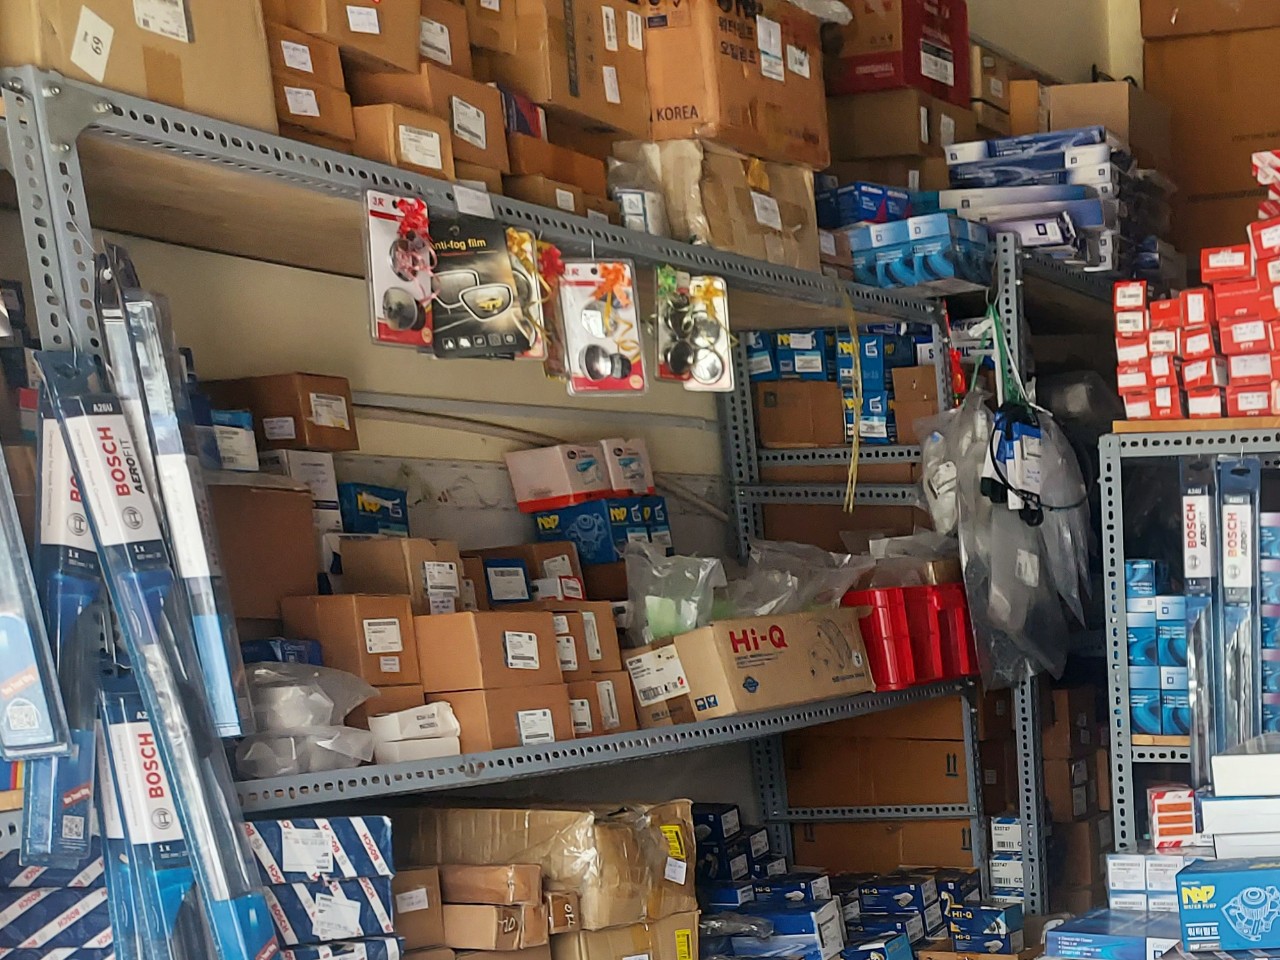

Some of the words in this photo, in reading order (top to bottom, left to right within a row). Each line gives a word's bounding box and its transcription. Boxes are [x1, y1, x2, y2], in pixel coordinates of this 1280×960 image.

[656, 105, 699, 121] KOREA
[467, 238, 487, 250] film
[97, 426, 131, 496] BOSCH
[119, 439, 145, 494] AEROFIT
[1186, 503, 1198, 549] BOSCH
[1227, 512, 1238, 558] BOSCH
[729, 624, 789, 653] Hi-Q
[138, 733, 164, 798] BOSCH
[363, 833, 380, 862] BOSCH
[18, 891, 41, 910] BOSCH
[57, 908, 81, 928] BOSCH
[271, 904, 289, 932] BOSCH
